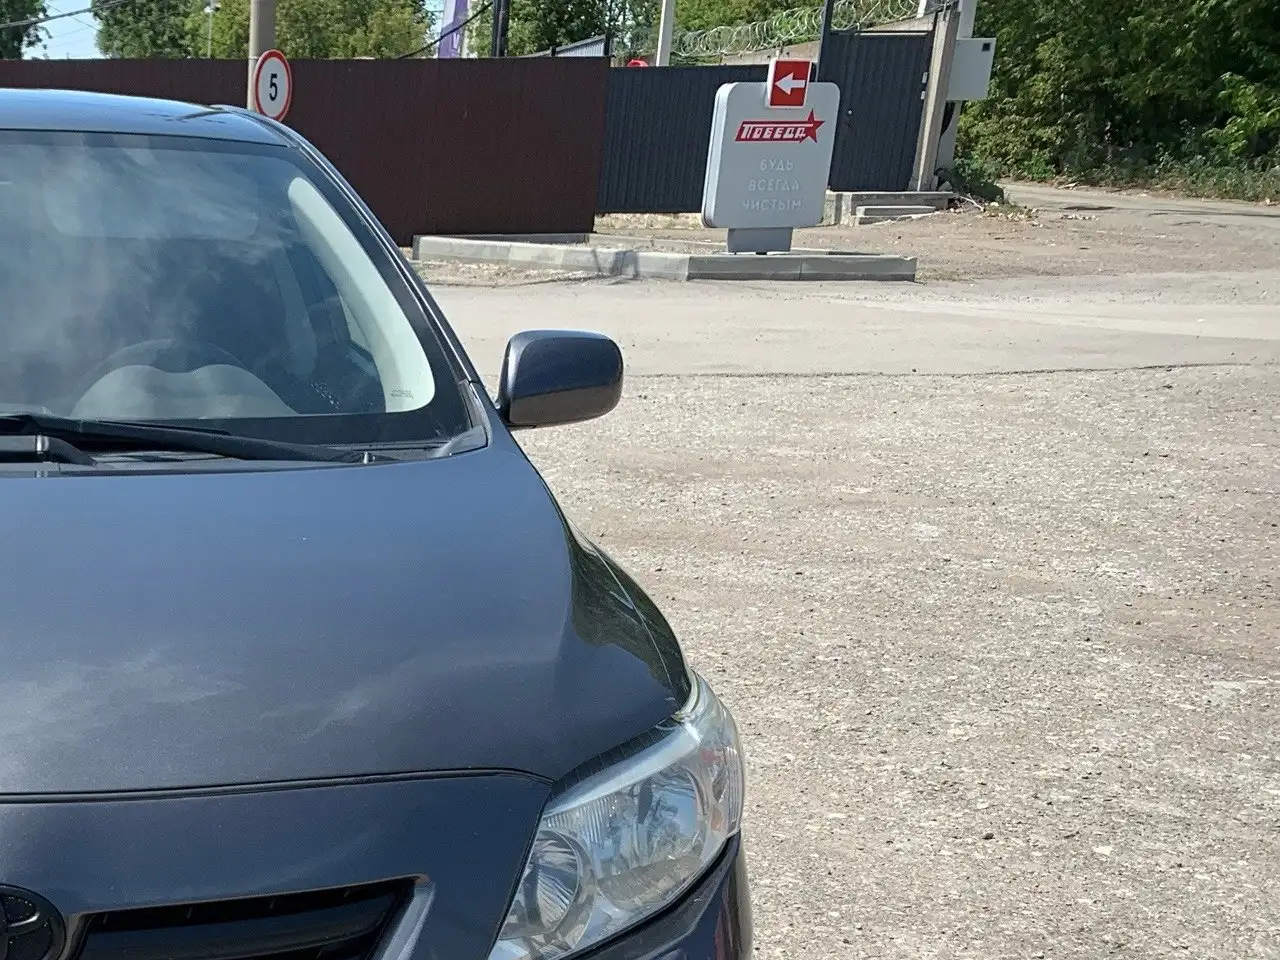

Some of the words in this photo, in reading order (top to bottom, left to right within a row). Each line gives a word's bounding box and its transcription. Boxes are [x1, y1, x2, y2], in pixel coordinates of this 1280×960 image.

[269, 73, 278, 101] 5
[760, 158, 794, 171] БУДЬ
[748, 178, 800, 191] ВСЕГДА
[742, 198, 803, 211] ЧИСТЫМ
